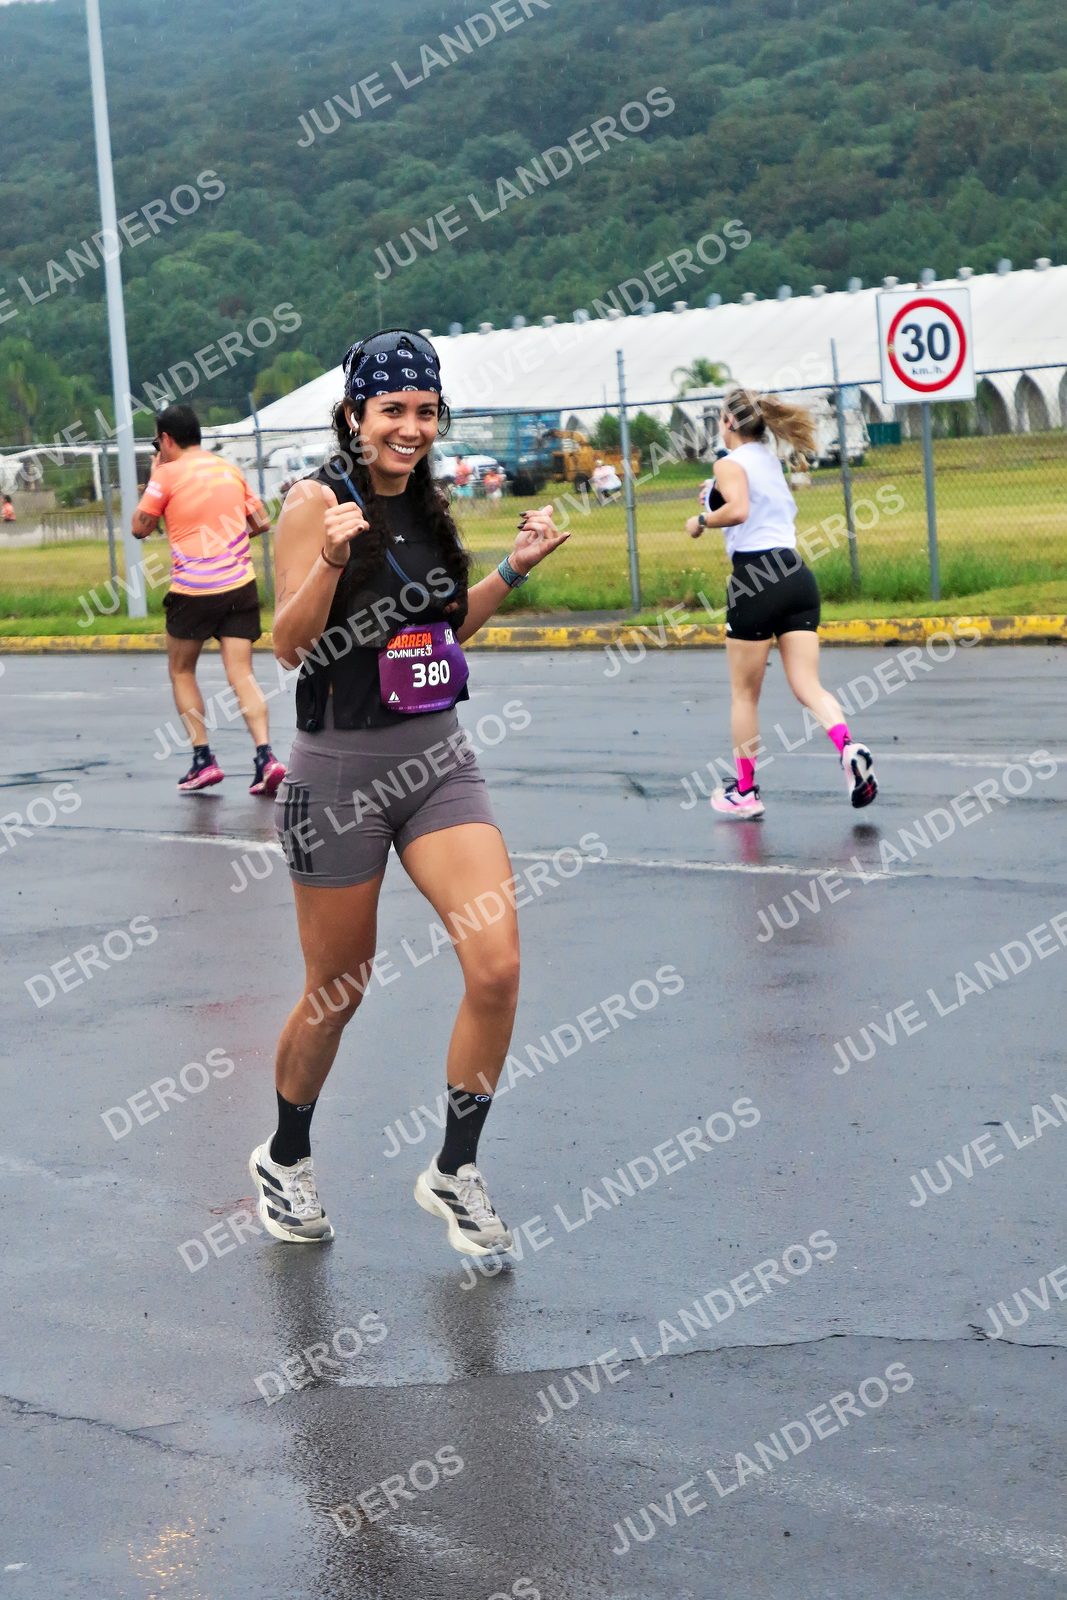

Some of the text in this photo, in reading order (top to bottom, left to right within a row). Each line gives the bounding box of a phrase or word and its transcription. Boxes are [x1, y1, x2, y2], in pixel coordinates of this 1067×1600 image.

[901, 321, 951, 362] 30
[387, 632, 432, 649] CARRERA
[387, 648, 425, 659] OMNILIFE
[412, 660, 450, 688] 380
